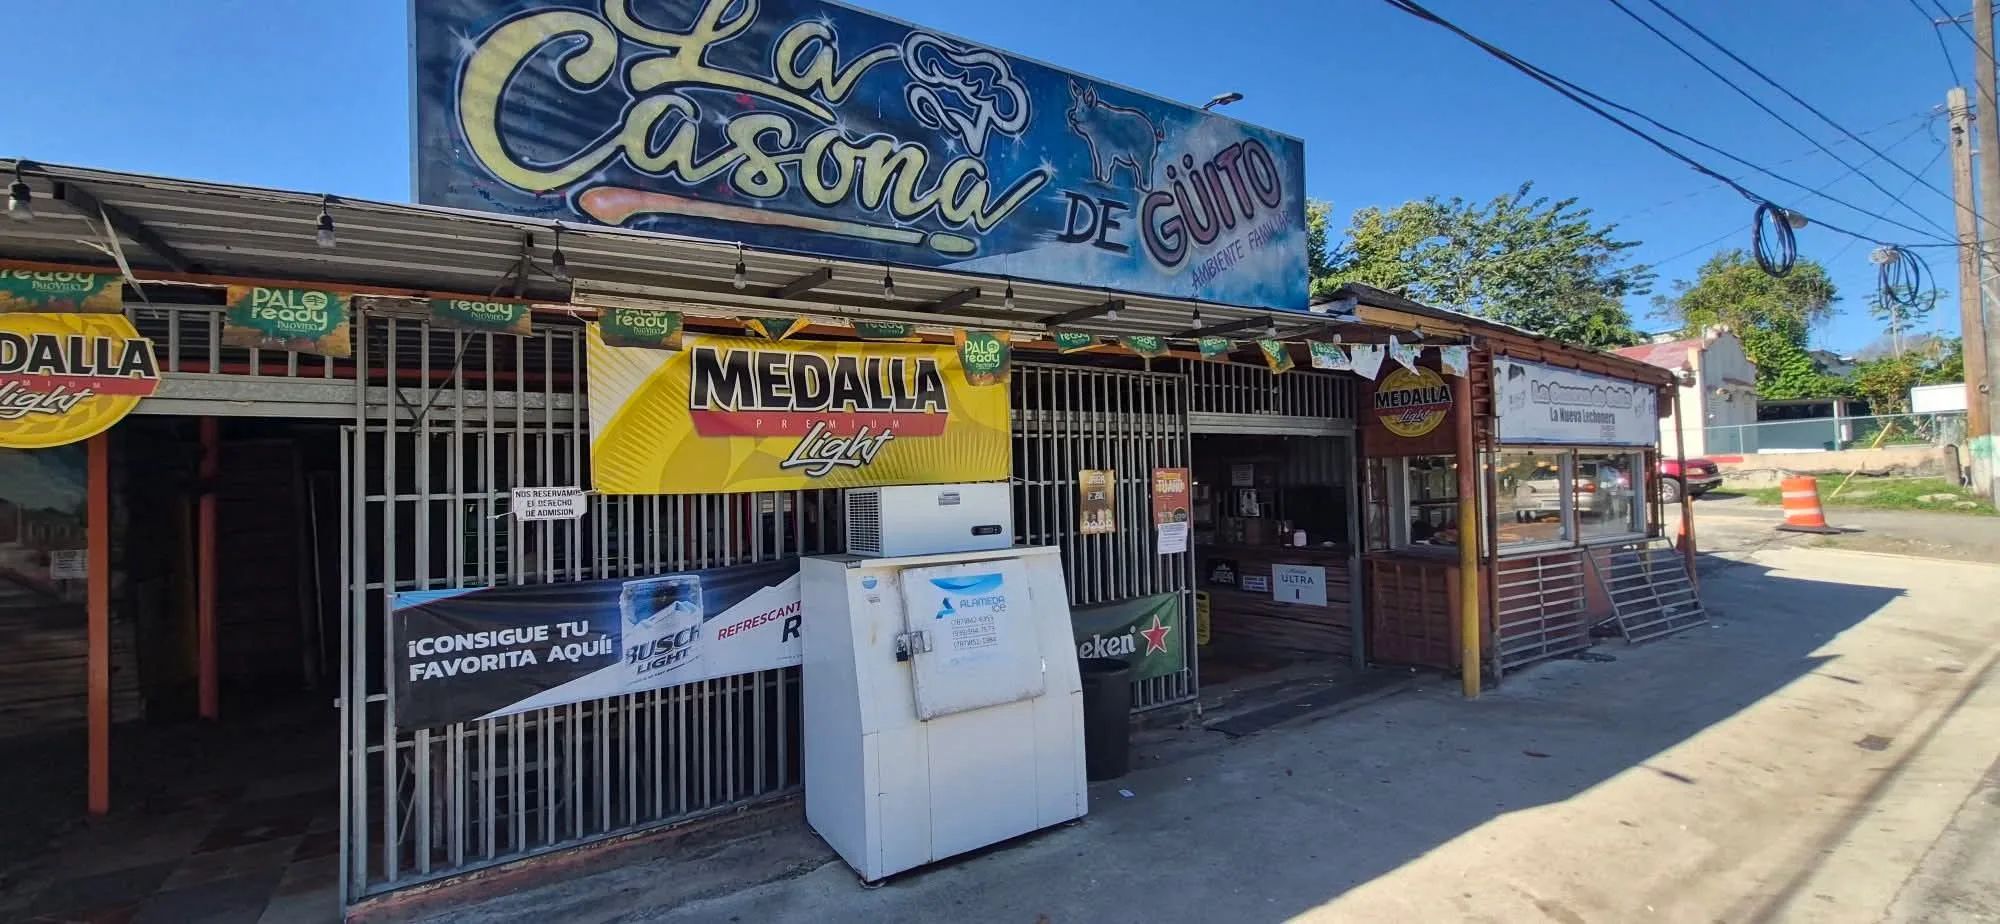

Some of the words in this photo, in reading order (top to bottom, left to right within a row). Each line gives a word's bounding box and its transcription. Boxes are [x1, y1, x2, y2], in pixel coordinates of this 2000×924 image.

[605, 0, 900, 123] La
[458, 9, 1052, 232] Casona
[1057, 190, 1130, 253] DE
[1141, 137, 1283, 269] GÜITO
[1191, 239, 1245, 290] AMBIENTE
[1247, 210, 1291, 250] FAMILIAR
[252, 286, 328, 311] PALO
[449, 300, 513, 321] ready
[251, 305, 328, 331] ready
[615, 313, 668, 335] ready
[964, 339, 1001, 354] PALO
[964, 352, 1001, 368] ready
[690, 346, 949, 413] MEDALLA
[1375, 384, 1453, 409] MEDALLA
[756, 417, 902, 430] PREMIUM
[1550, 407, 1559, 422] La
[780, 421, 895, 477] Light
[515, 490, 532, 498] NOS
[533, 489, 583, 498] RESERVAMOS
[538, 499, 572, 507] DERECHO
[1281, 575, 1314, 585] ULTRA
[959, 595, 1006, 609] ALAMEDA
[408, 625, 549, 658] ¡CONSIGUE
[556, 620, 589, 639] TU
[408, 649, 538, 682] FAVORITA
[547, 635, 613, 664] AQUÍ!
[637, 647, 692, 675] LIGHT
